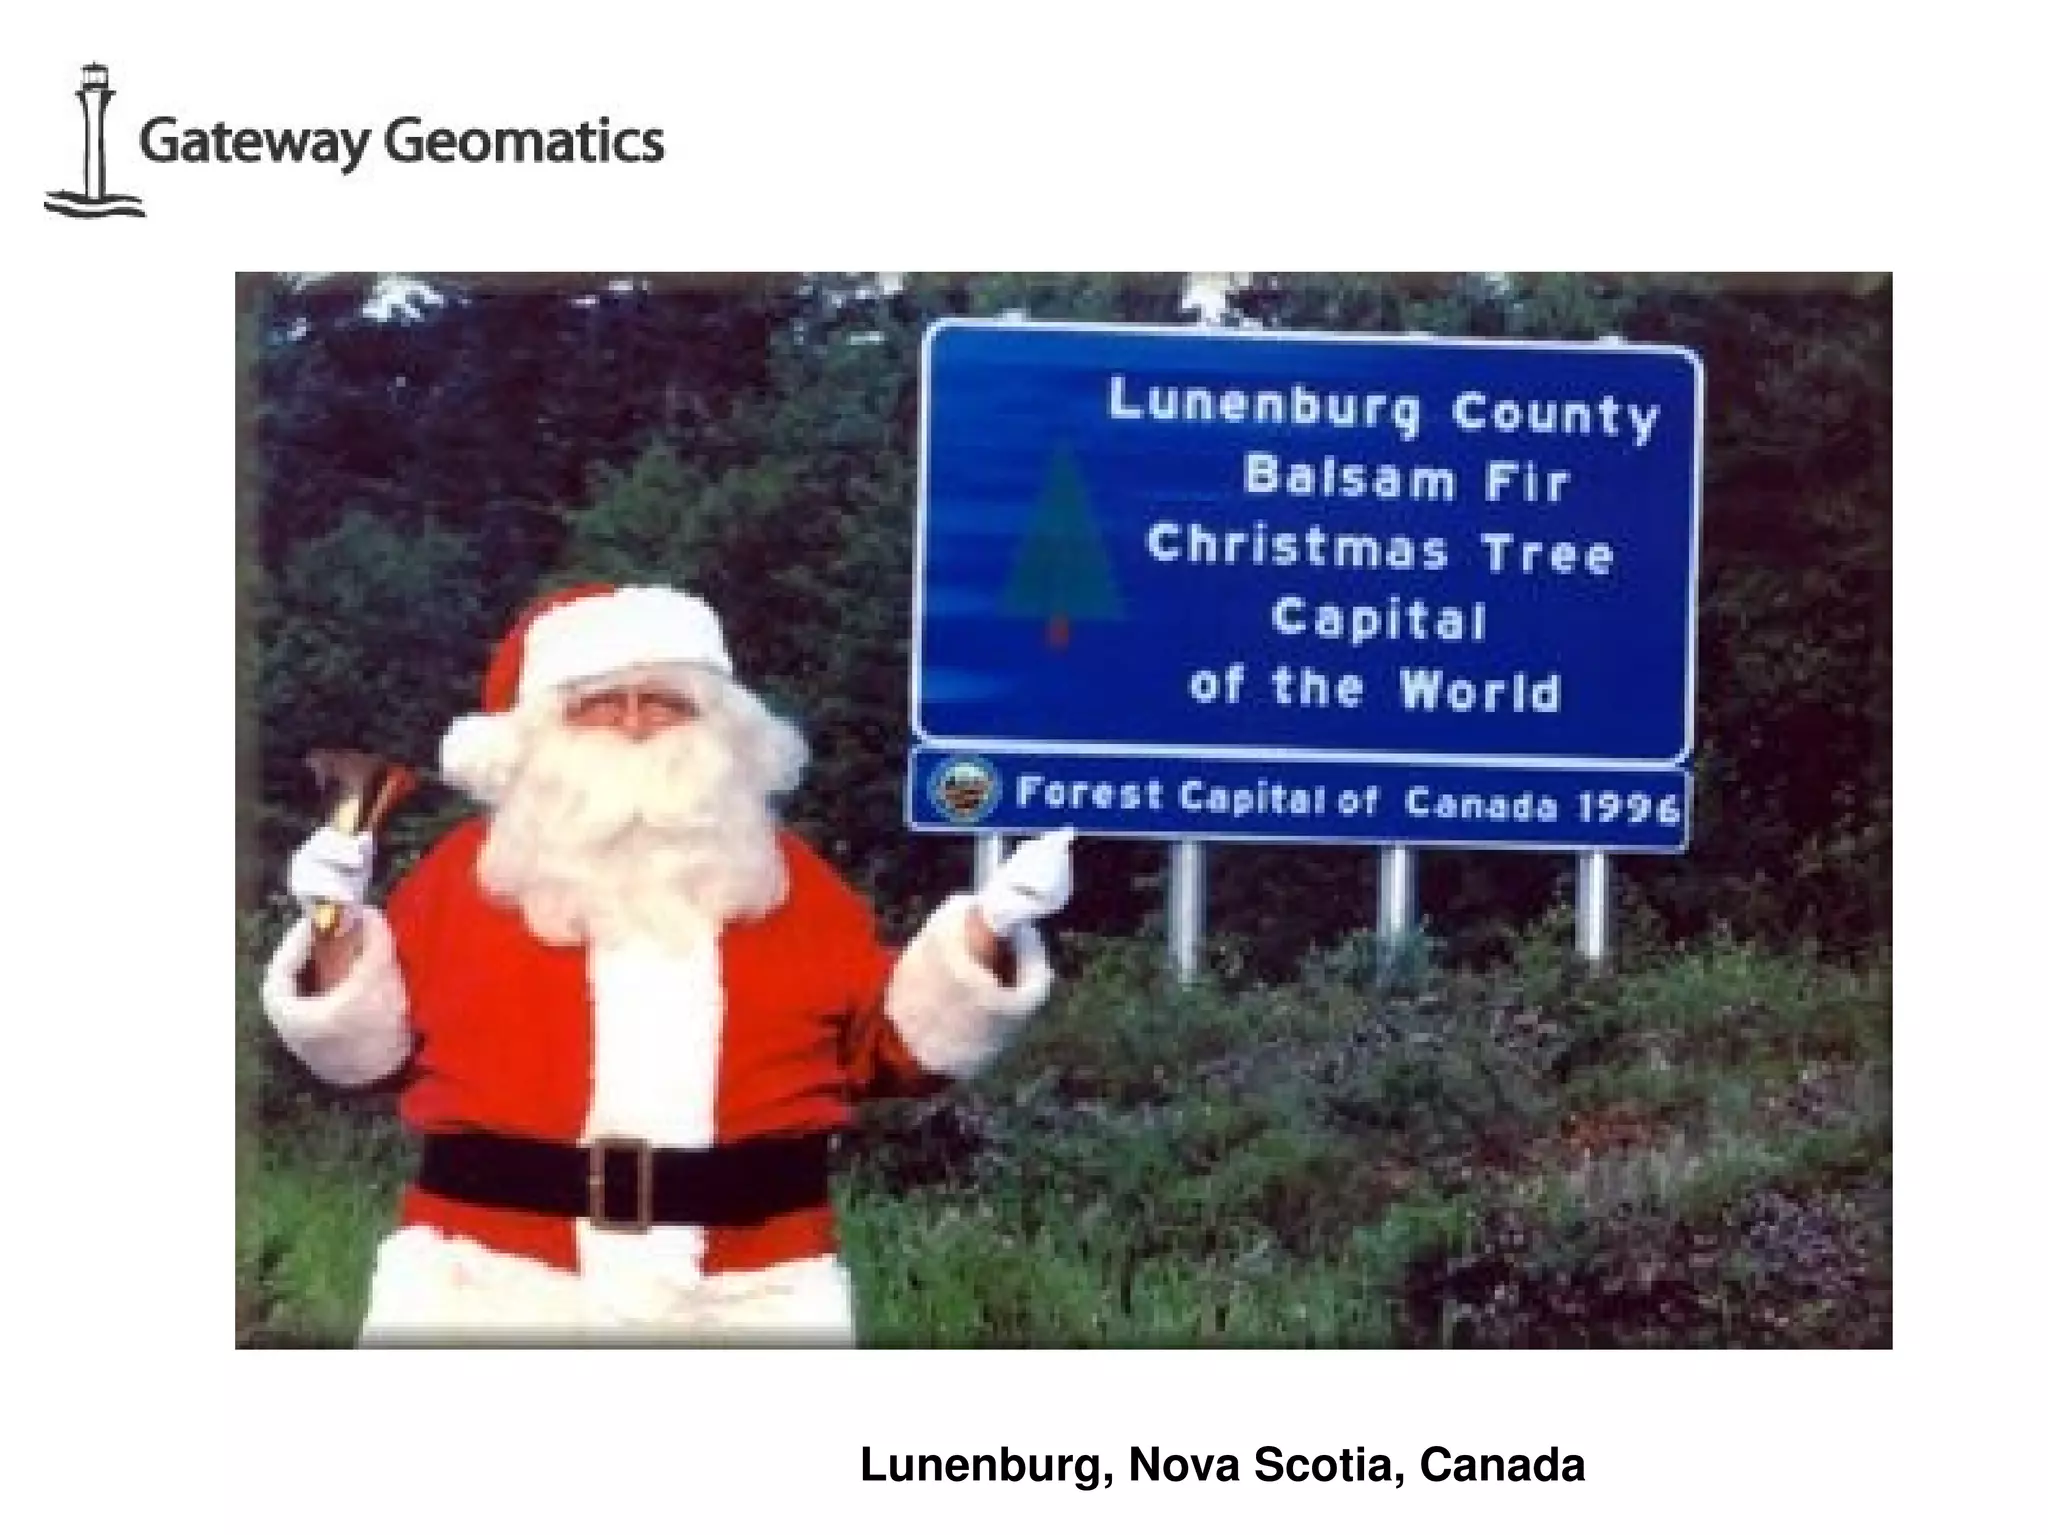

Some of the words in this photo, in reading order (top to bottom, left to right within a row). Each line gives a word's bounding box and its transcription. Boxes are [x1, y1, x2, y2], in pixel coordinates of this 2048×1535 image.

[1108, 376, 1422, 442] Lunenburg
[1451, 389, 1660, 447] County
[1242, 453, 1457, 502] Balsam
[1487, 462, 1570, 503] Fir
[1146, 522, 1449, 571] Christmas
[1480, 531, 1616, 576] Tree
[1271, 596, 1487, 645] Capital
[1189, 664, 1246, 705] of
[1271, 664, 1364, 709] the
[1397, 669, 1562, 714] World
[1016, 773, 1163, 811] Forest
[1178, 780, 1326, 819] Capital
[1335, 785, 1379, 815] of
[1403, 785, 1560, 824] Canada
[1578, 790, 1681, 825] 1996
